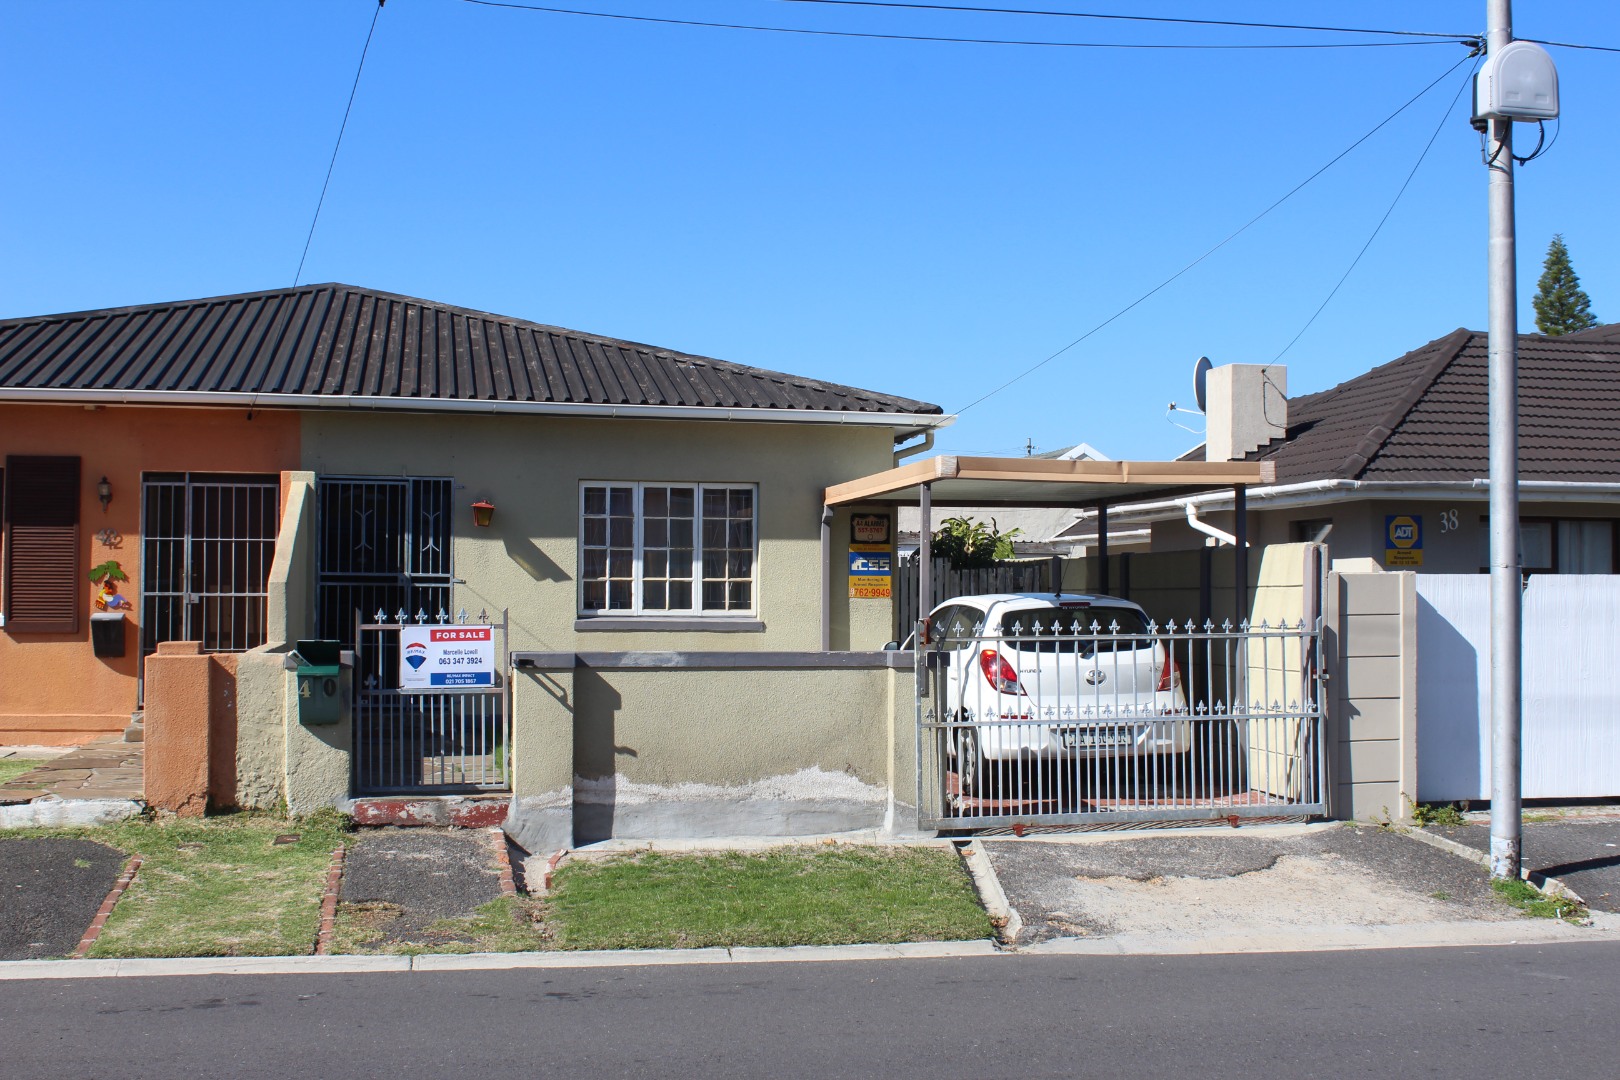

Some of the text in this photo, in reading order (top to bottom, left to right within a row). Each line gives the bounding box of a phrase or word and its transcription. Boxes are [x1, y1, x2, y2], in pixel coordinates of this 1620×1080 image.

[1440, 509, 1459, 533] 38
[95, 528, 117, 545] 42
[1395, 526, 1413, 538] ADT
